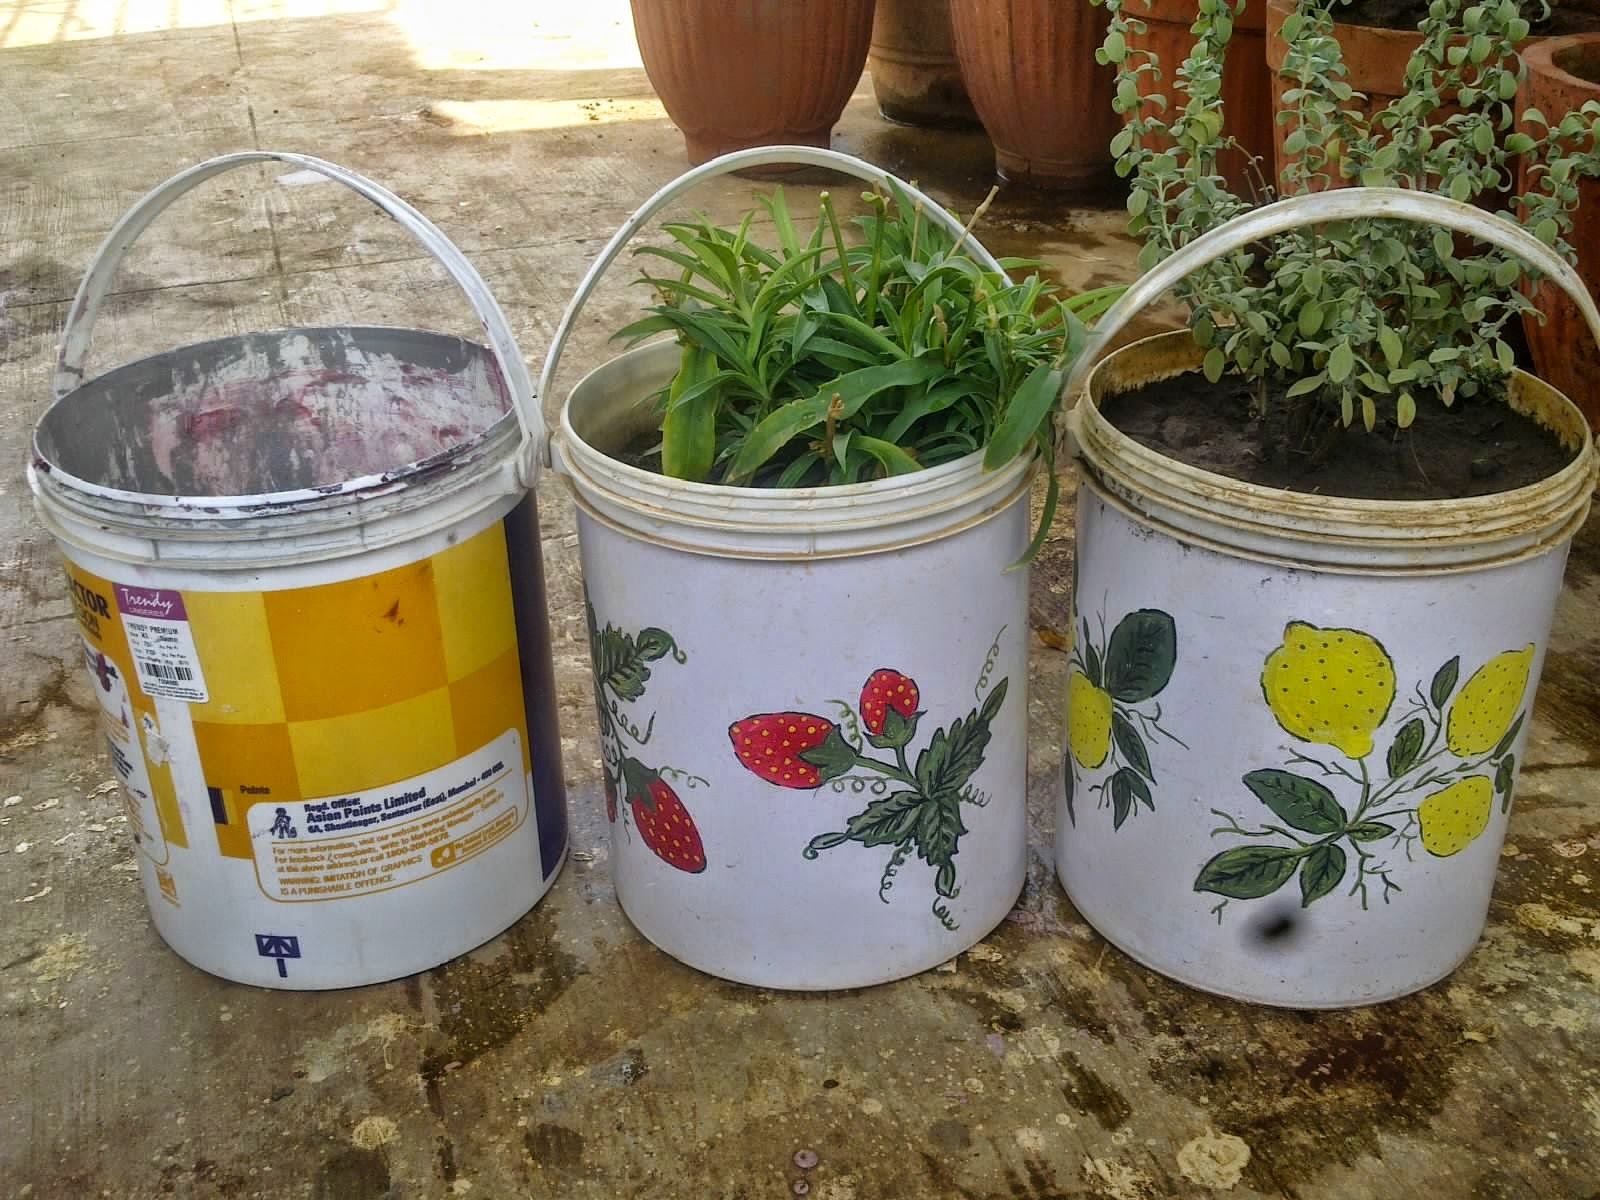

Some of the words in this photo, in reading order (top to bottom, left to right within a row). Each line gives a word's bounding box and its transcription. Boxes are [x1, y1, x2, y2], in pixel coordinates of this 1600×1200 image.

[120, 588, 173, 615] Trendy
[150, 625, 178, 634] PREMIUM
[240, 785, 270, 795] Paints
[447, 777, 477, 798] Mumbai
[304, 802, 330, 812] Regd.
[306, 810, 341, 823] Asian
[344, 802, 382, 818] Paints
[384, 787, 426, 810] Limited
[323, 870, 366, 882] IMITATION
[367, 867, 378, 876] OF
[380, 855, 423, 873] GRAPHICS
[298, 882, 353, 896] PUNISHABLE
